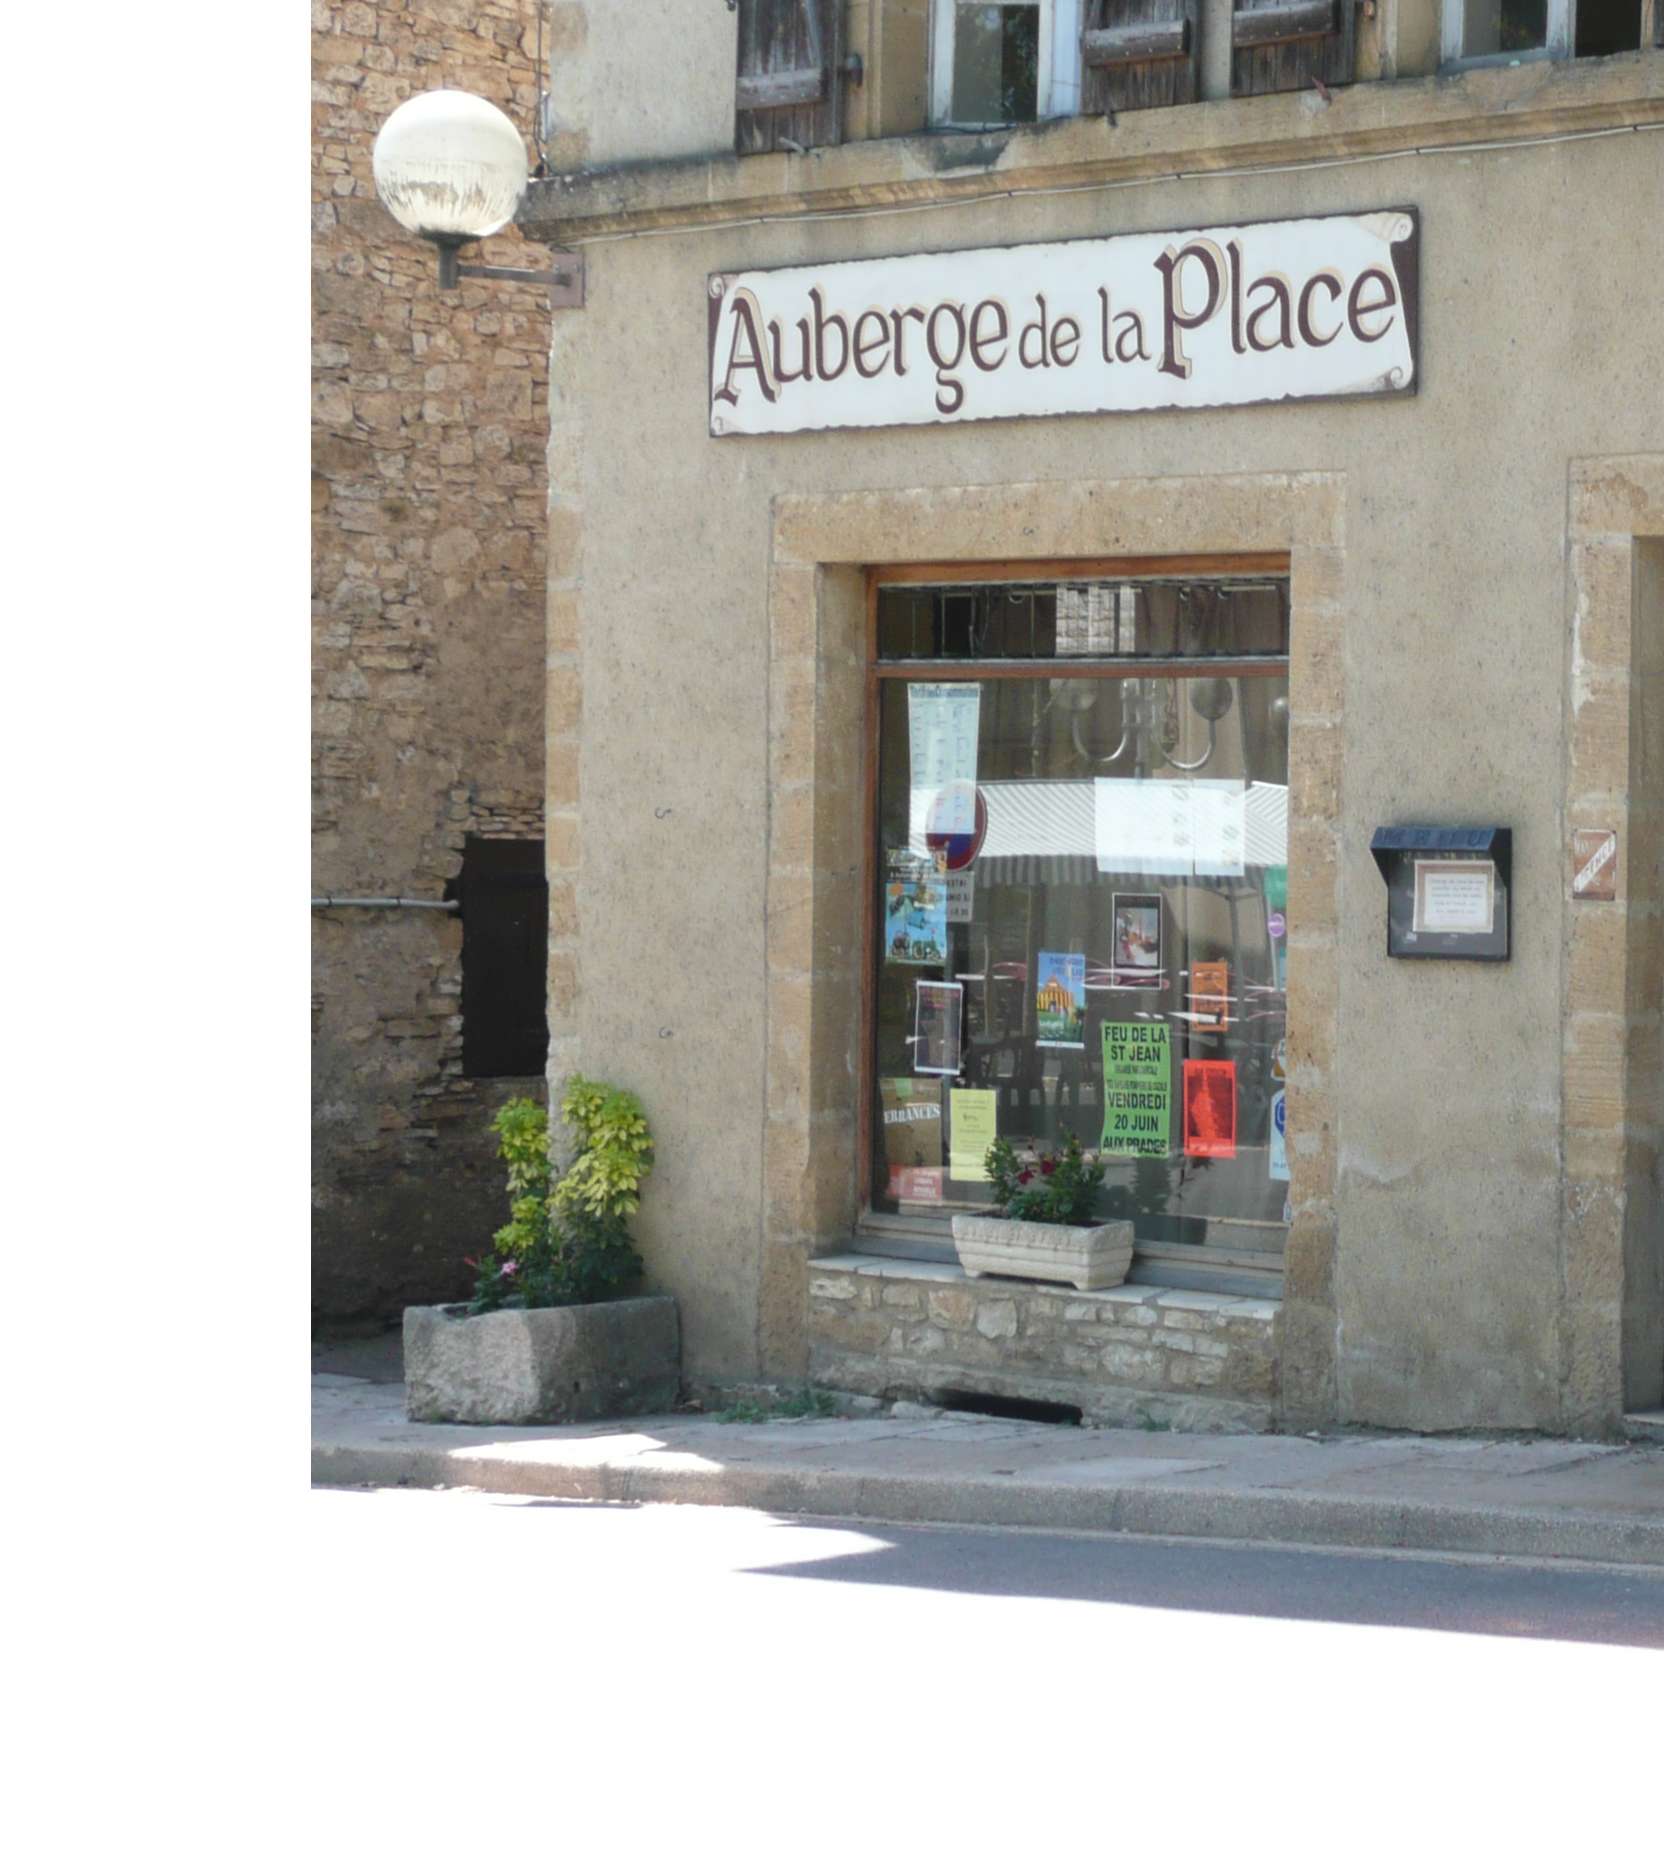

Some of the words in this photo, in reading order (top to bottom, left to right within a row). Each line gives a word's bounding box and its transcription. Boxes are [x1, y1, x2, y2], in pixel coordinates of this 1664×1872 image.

[714, 285, 1008, 414] Auberge
[1018, 293, 1081, 368] de
[1097, 286, 1151, 364] la
[1152, 237, 1397, 379] Place
[1104, 1025, 1128, 1042] FEU
[1131, 1026, 1148, 1042] DE
[1151, 1026, 1167, 1044] LA
[1111, 1044, 1126, 1061] ST
[1129, 1045, 1161, 1062] JEAN
[1108, 1091, 1167, 1110] VENDREDI
[883, 1103, 941, 1124] ERRANCES
[1114, 1113, 1128, 1131] 20
[1131, 1114, 1158, 1133] JUIN
[1103, 1136, 1125, 1151] AUX
